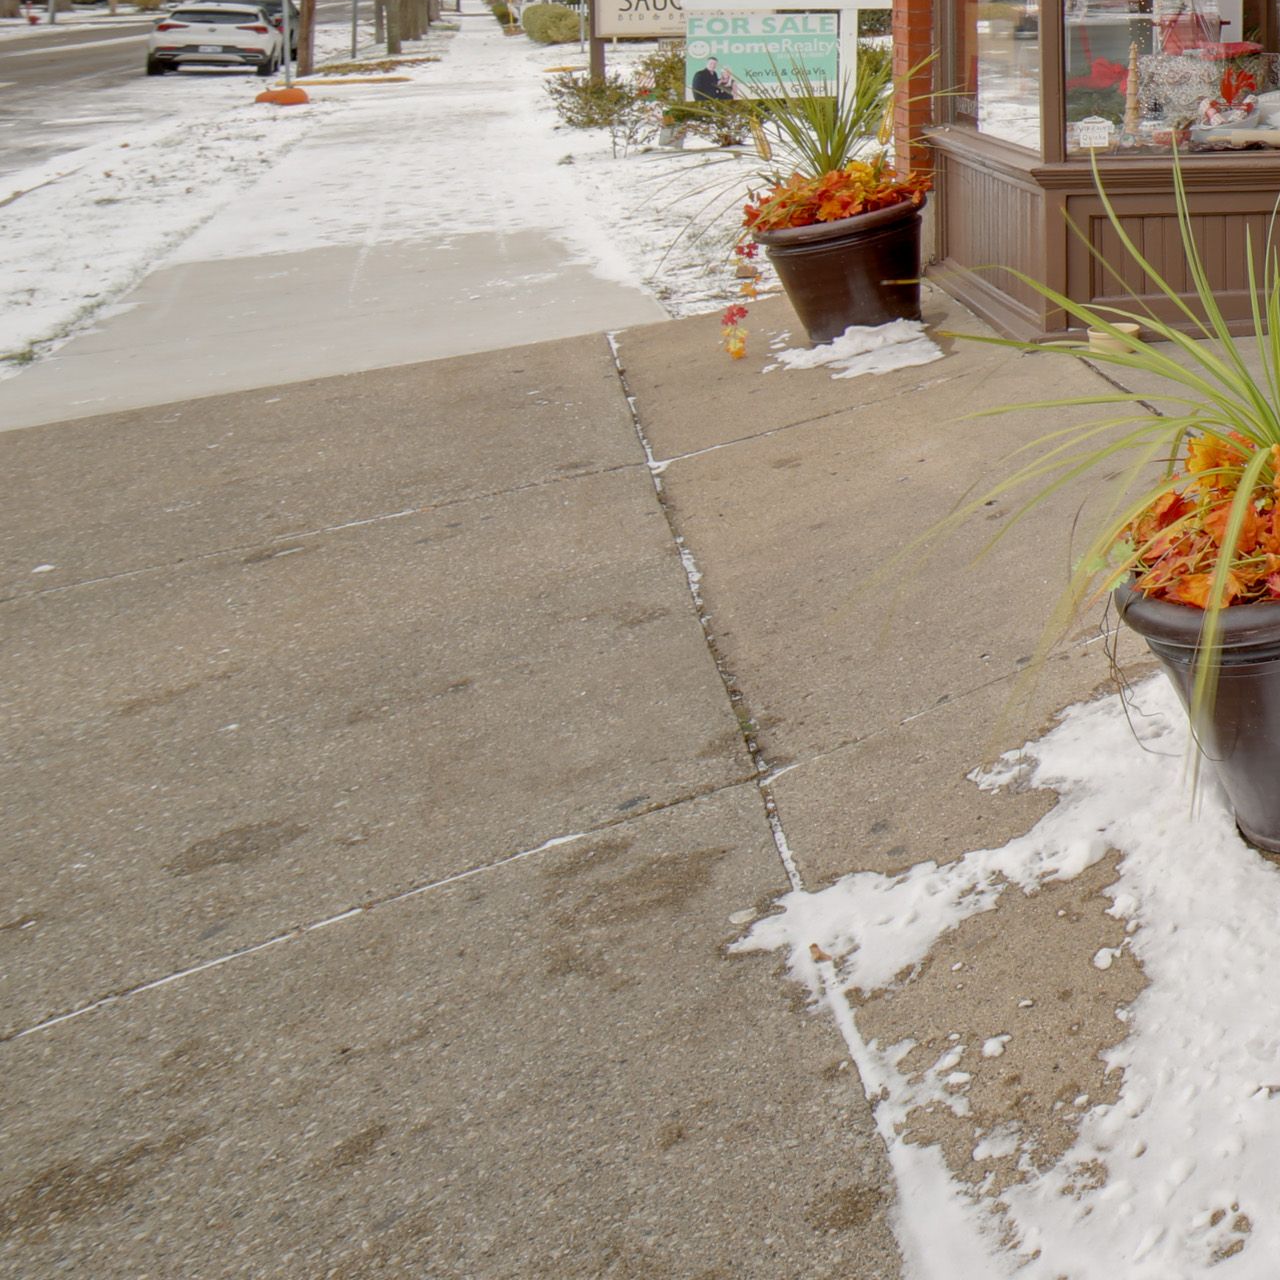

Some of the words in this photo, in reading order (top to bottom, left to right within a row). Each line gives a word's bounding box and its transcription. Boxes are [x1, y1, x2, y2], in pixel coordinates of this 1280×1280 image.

[688, 17, 750, 35] FOR
[762, 16, 834, 35] SALE
[745, 69, 763, 78] Ken
[791, 84, 825, 95] Gup
